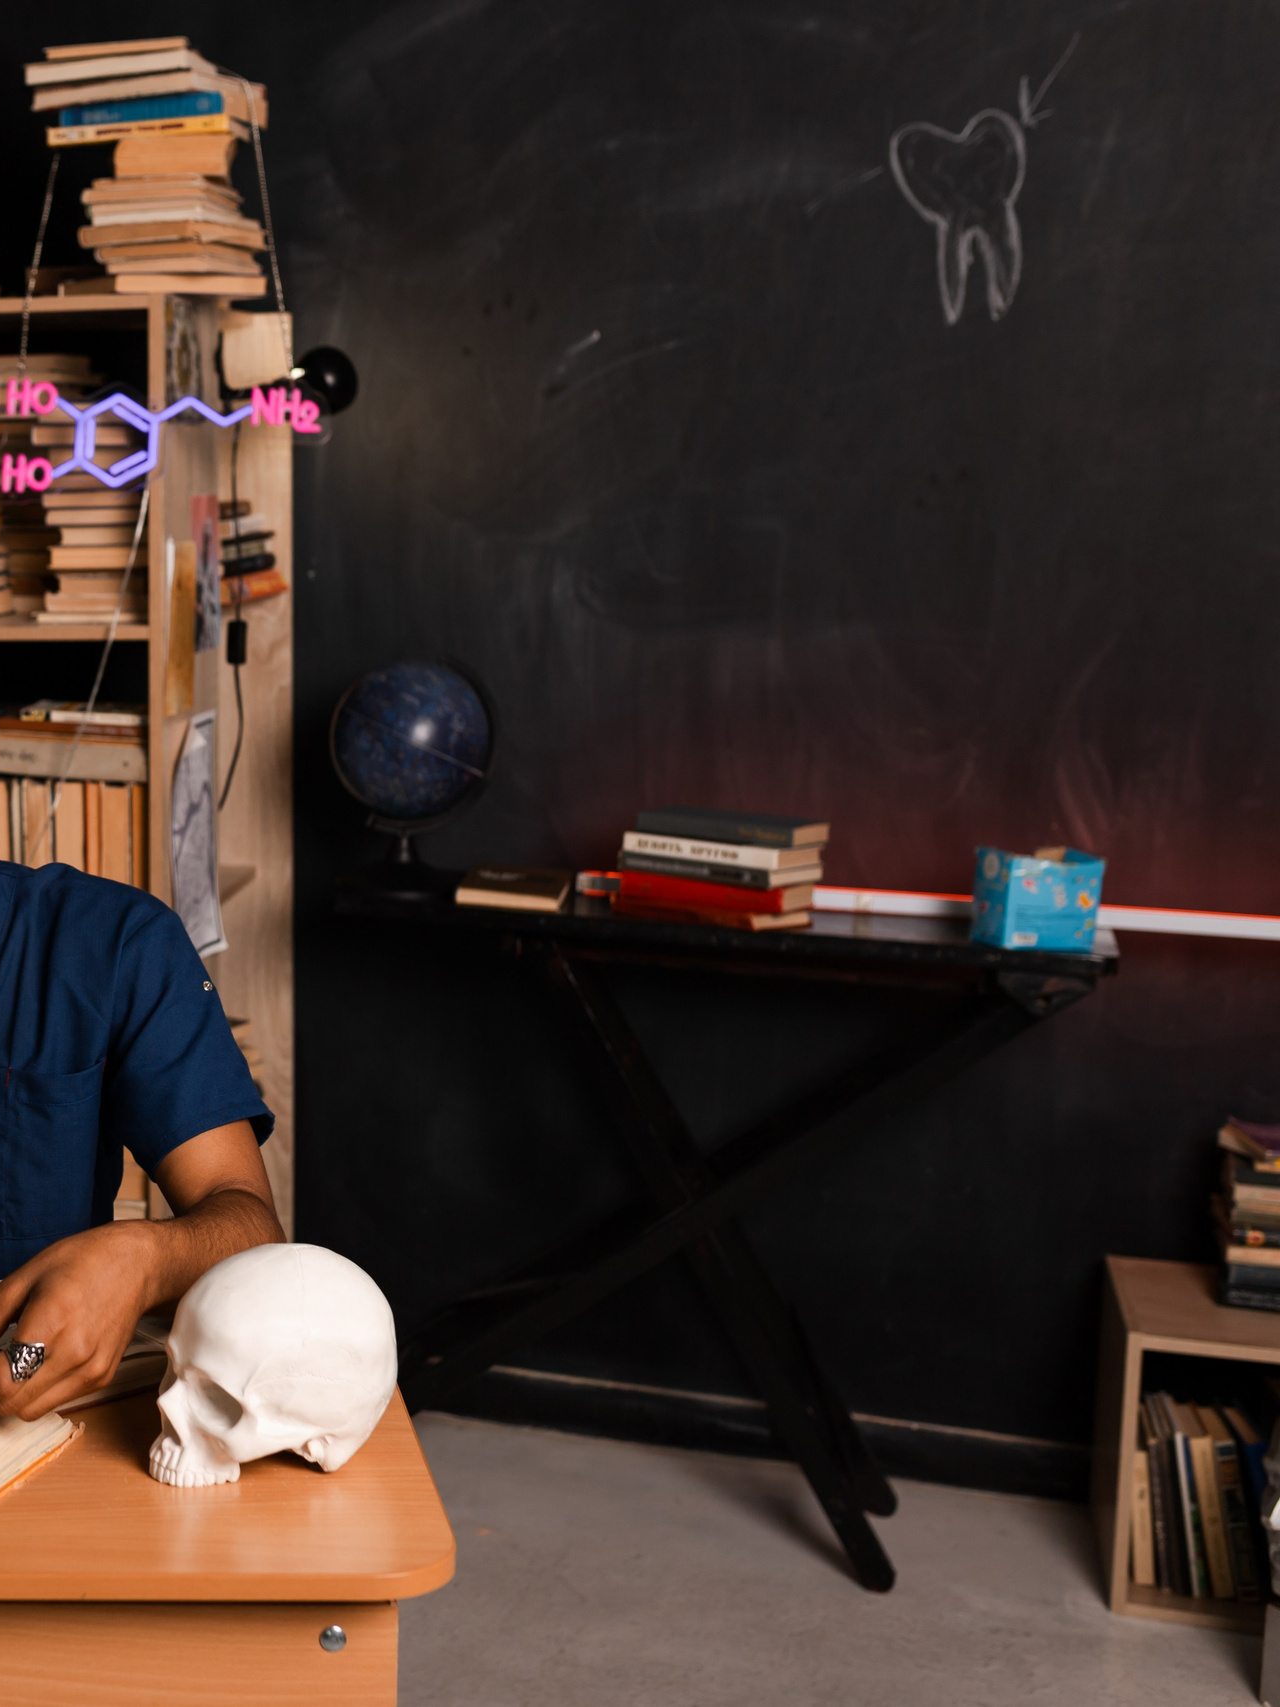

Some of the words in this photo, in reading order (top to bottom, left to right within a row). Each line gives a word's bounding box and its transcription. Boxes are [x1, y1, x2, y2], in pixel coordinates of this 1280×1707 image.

[6, 377, 59, 417] HO
[250, 386, 322, 434] NH2
[1, 453, 54, 493] HO
